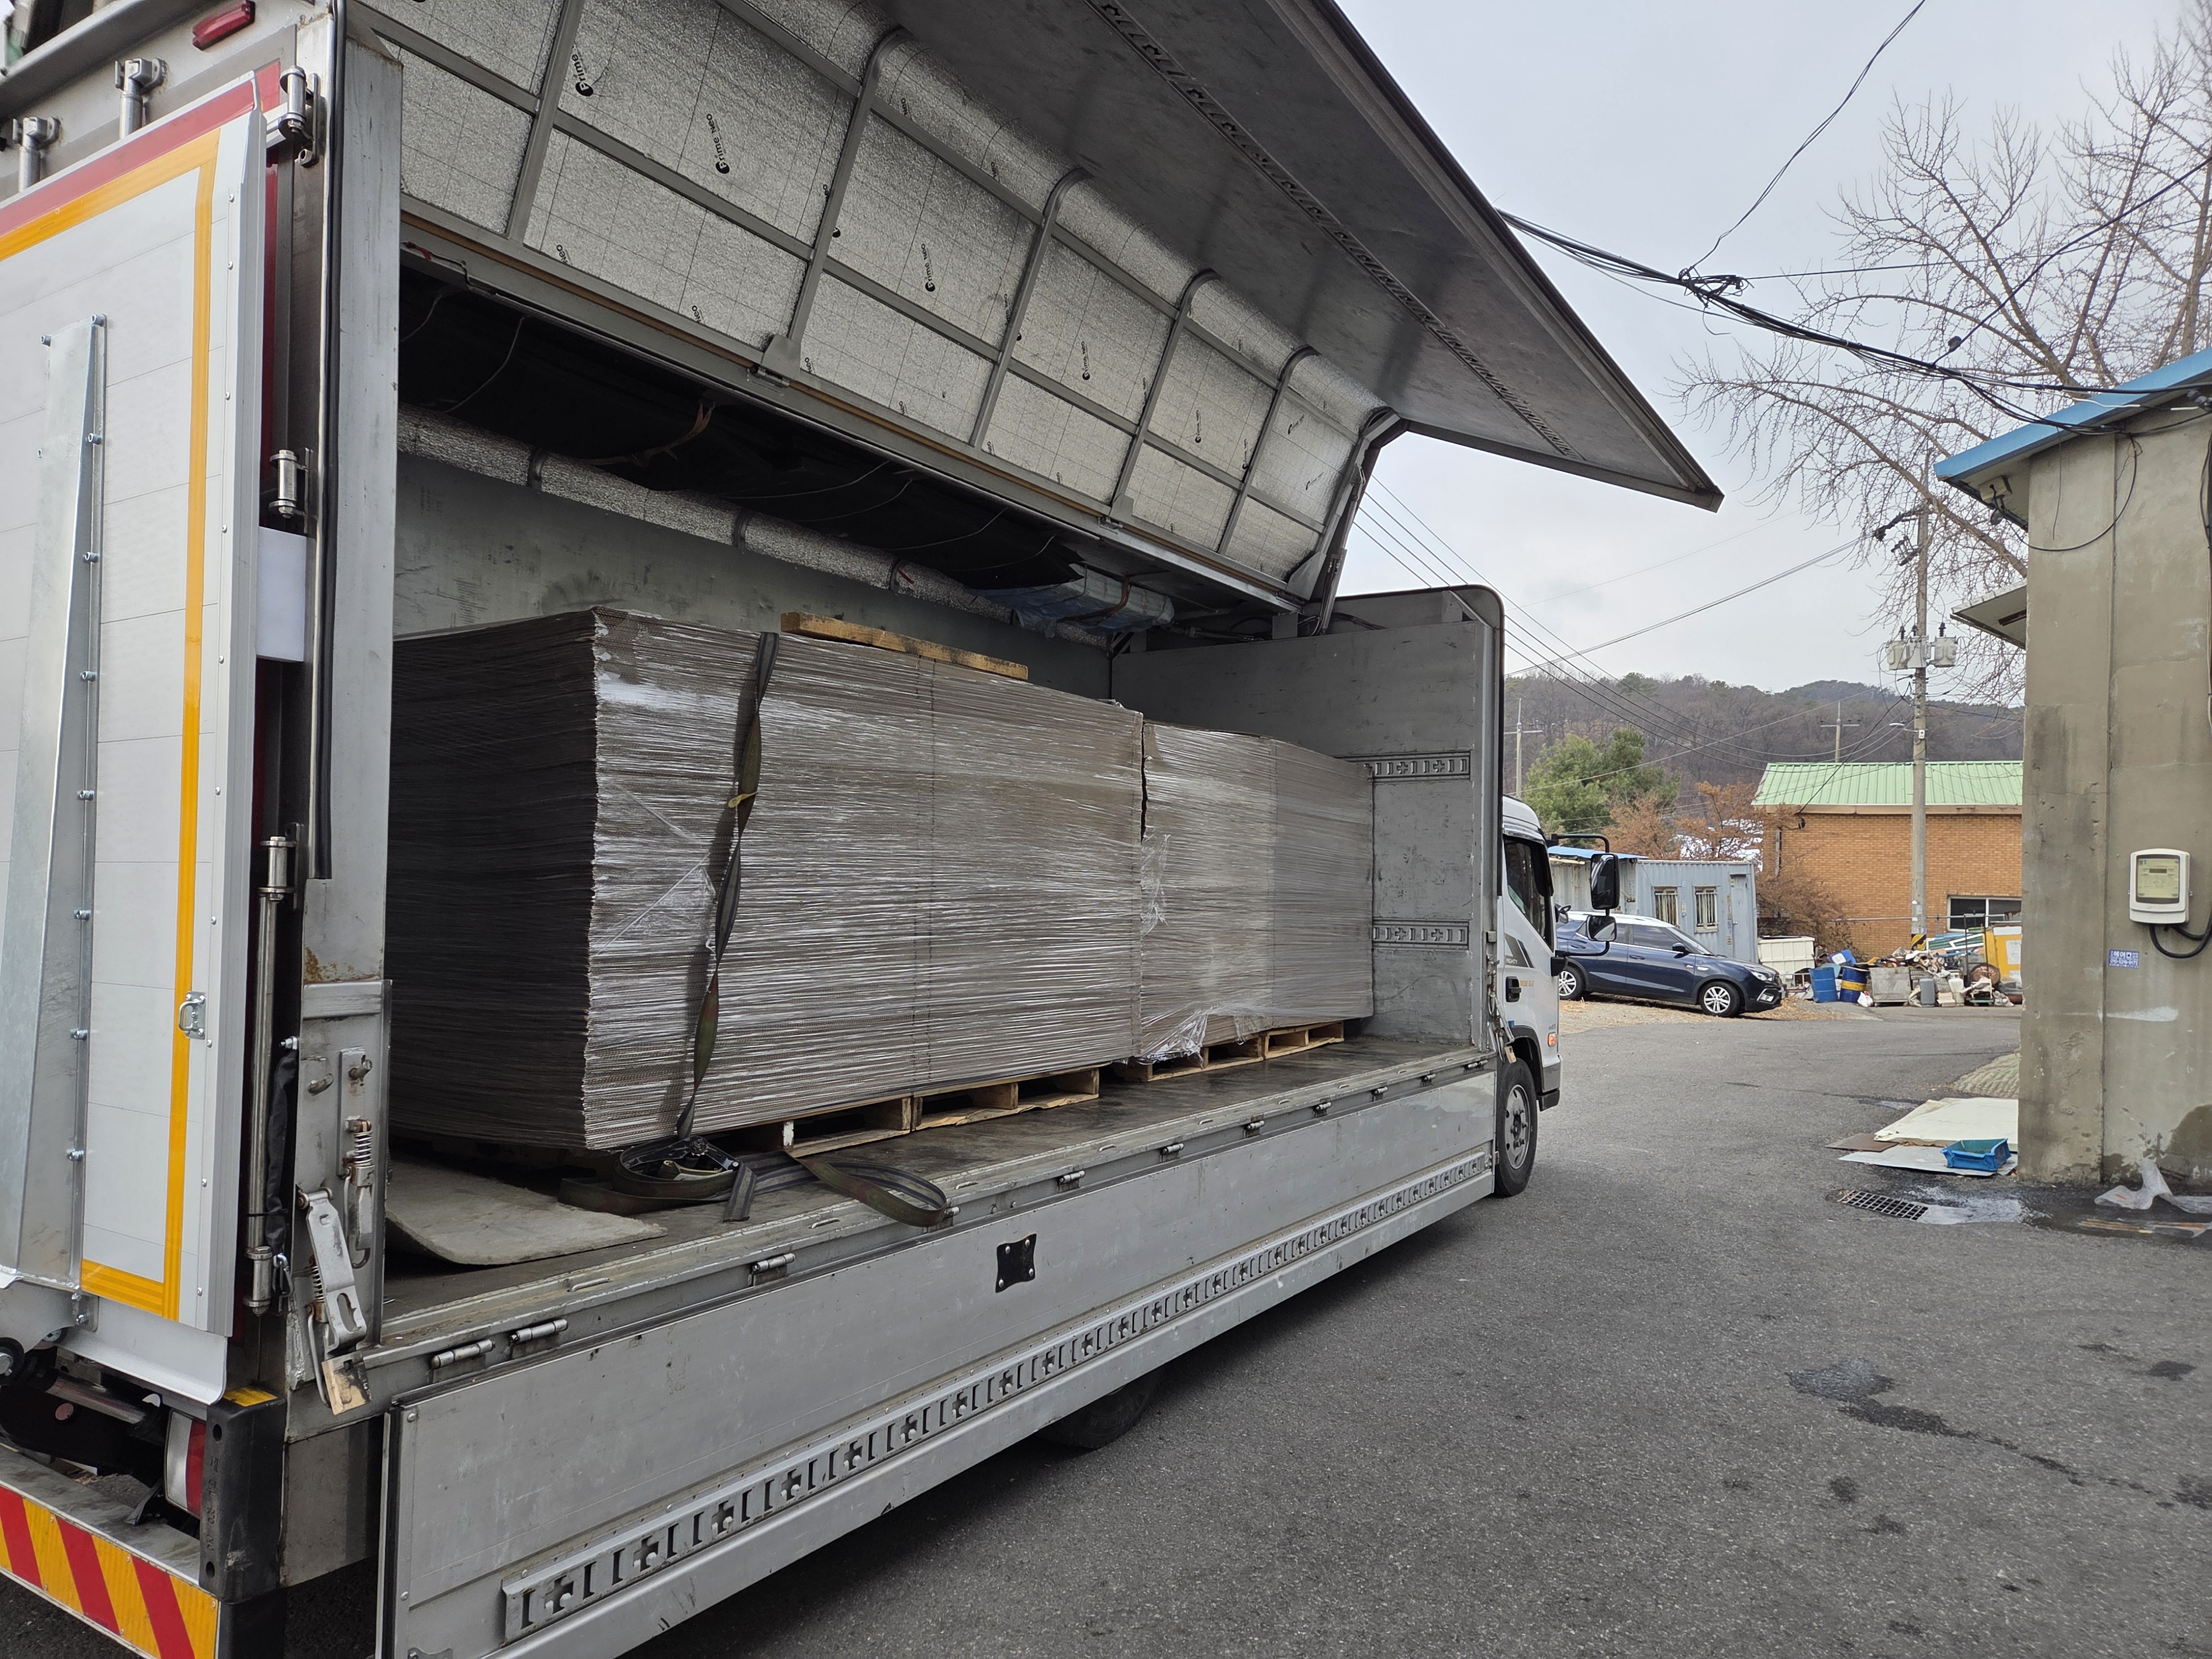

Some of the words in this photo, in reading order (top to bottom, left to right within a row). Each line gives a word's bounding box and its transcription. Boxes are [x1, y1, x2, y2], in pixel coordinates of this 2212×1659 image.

[572, 54, 591, 93] Prime
[707, 114, 716, 133] Neo
[713, 137, 728, 171] Prime
[925, 262, 935, 290] Prime
